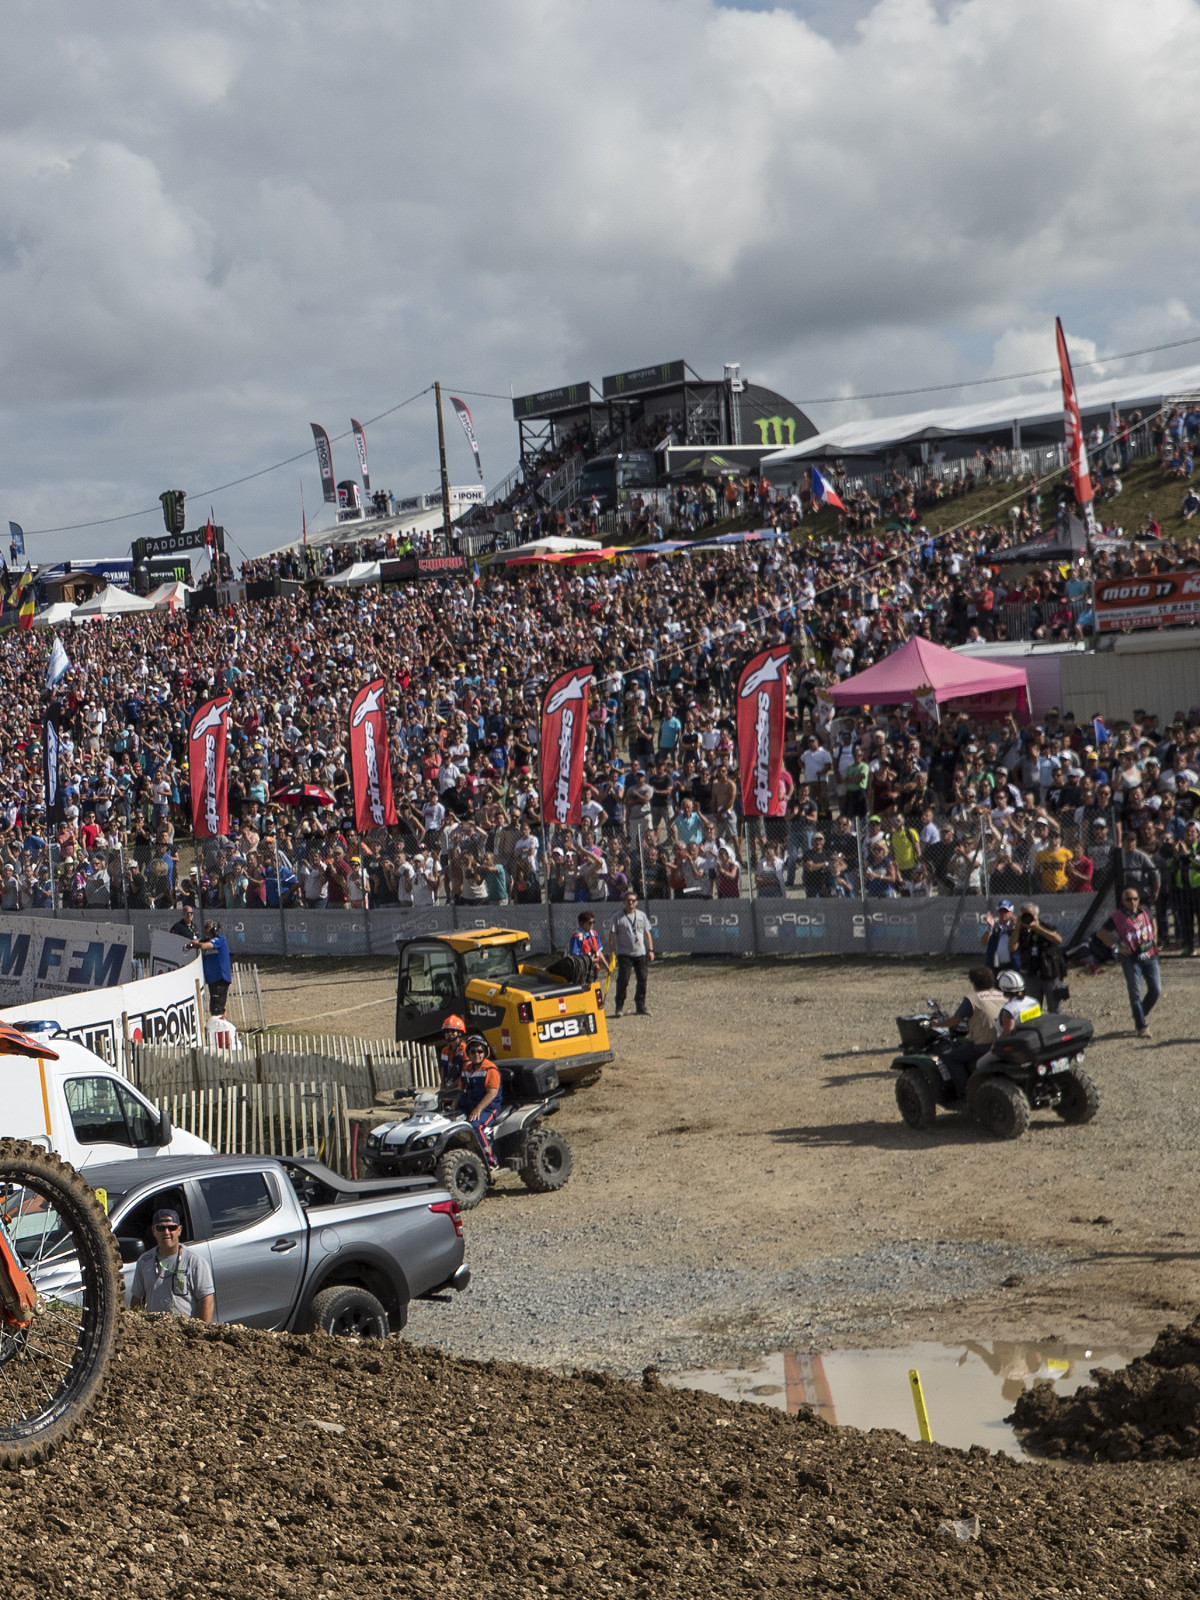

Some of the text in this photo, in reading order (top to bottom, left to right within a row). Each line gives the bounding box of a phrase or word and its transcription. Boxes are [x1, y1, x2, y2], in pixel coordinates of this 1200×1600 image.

[458, 491, 482, 501] IPONE
[146, 533, 201, 553] PADDOCK
[1103, 584, 1150, 600] MOTO
[1156, 582, 1172, 595] 17
[364, 720, 385, 826] alpinestars
[554, 708, 574, 824] alpinestars
[747, 691, 771, 814] alpinestars
[204, 734, 221, 835] alpinestars
[538, 1018, 580, 1042] JCB
